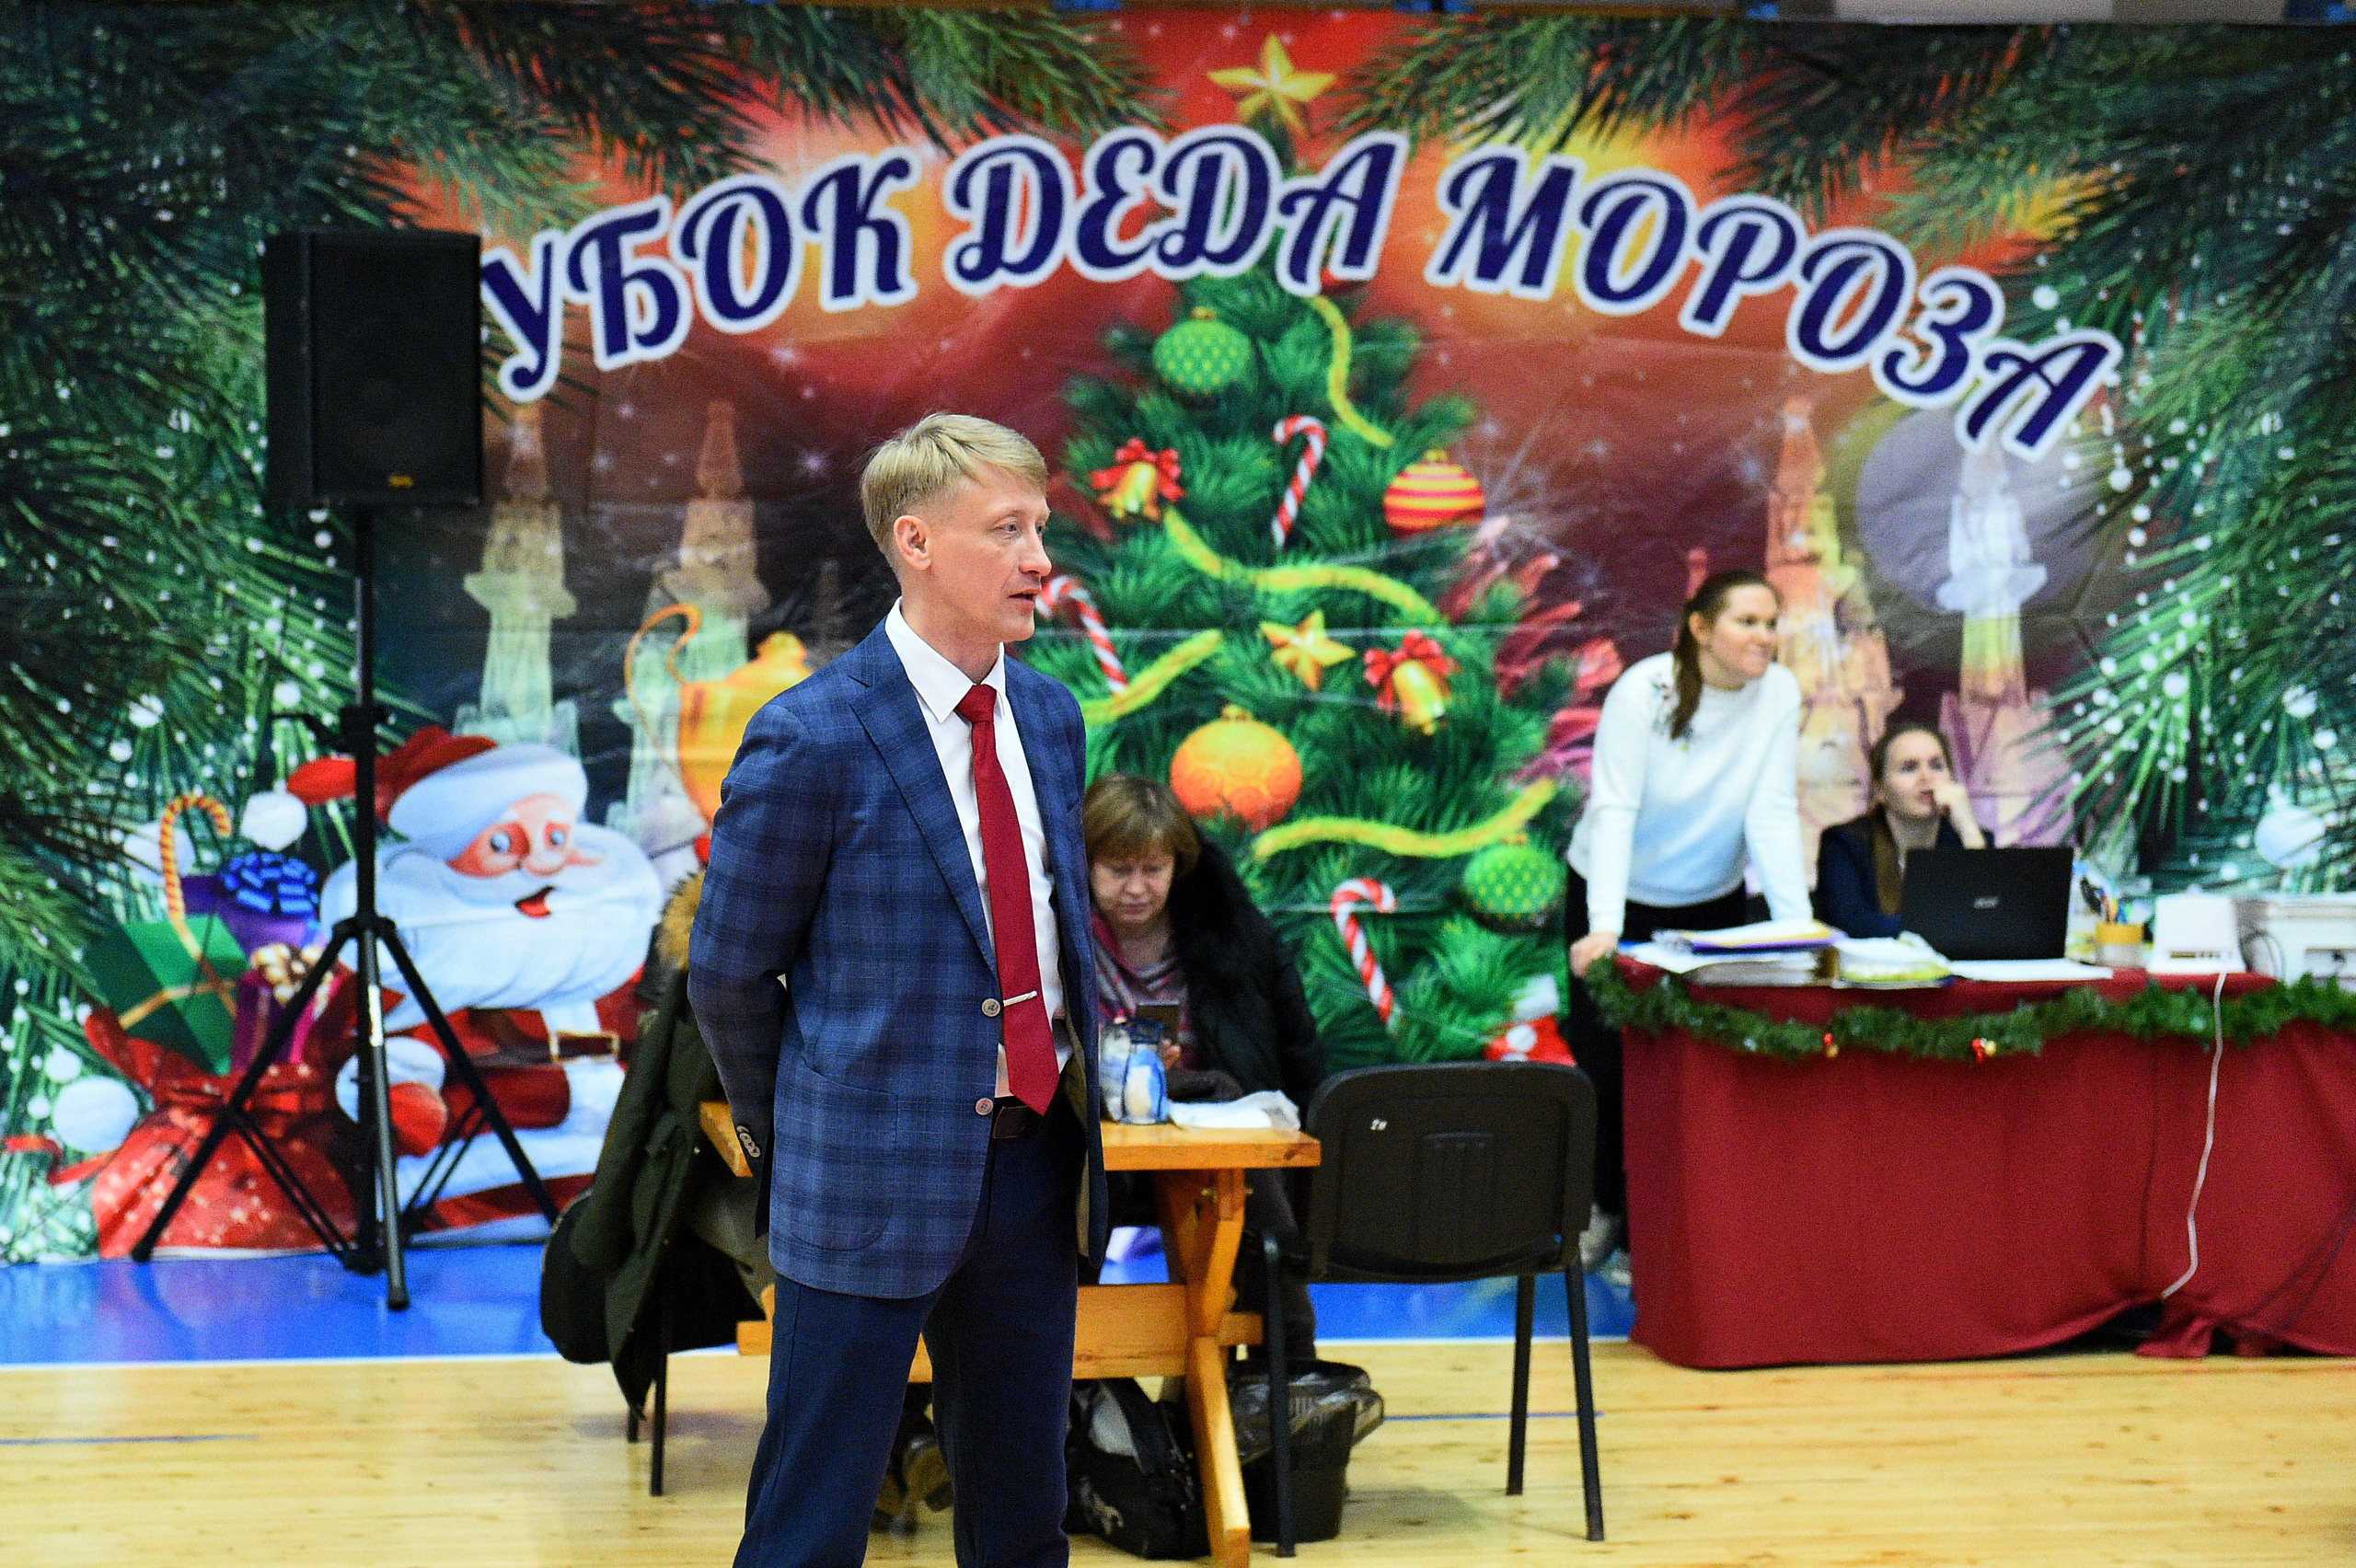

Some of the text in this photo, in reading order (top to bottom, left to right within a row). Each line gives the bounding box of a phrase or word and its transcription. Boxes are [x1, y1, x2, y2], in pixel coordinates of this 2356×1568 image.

[481, 129, 2116, 457] УБОК ДЕДА МОРОЗА
